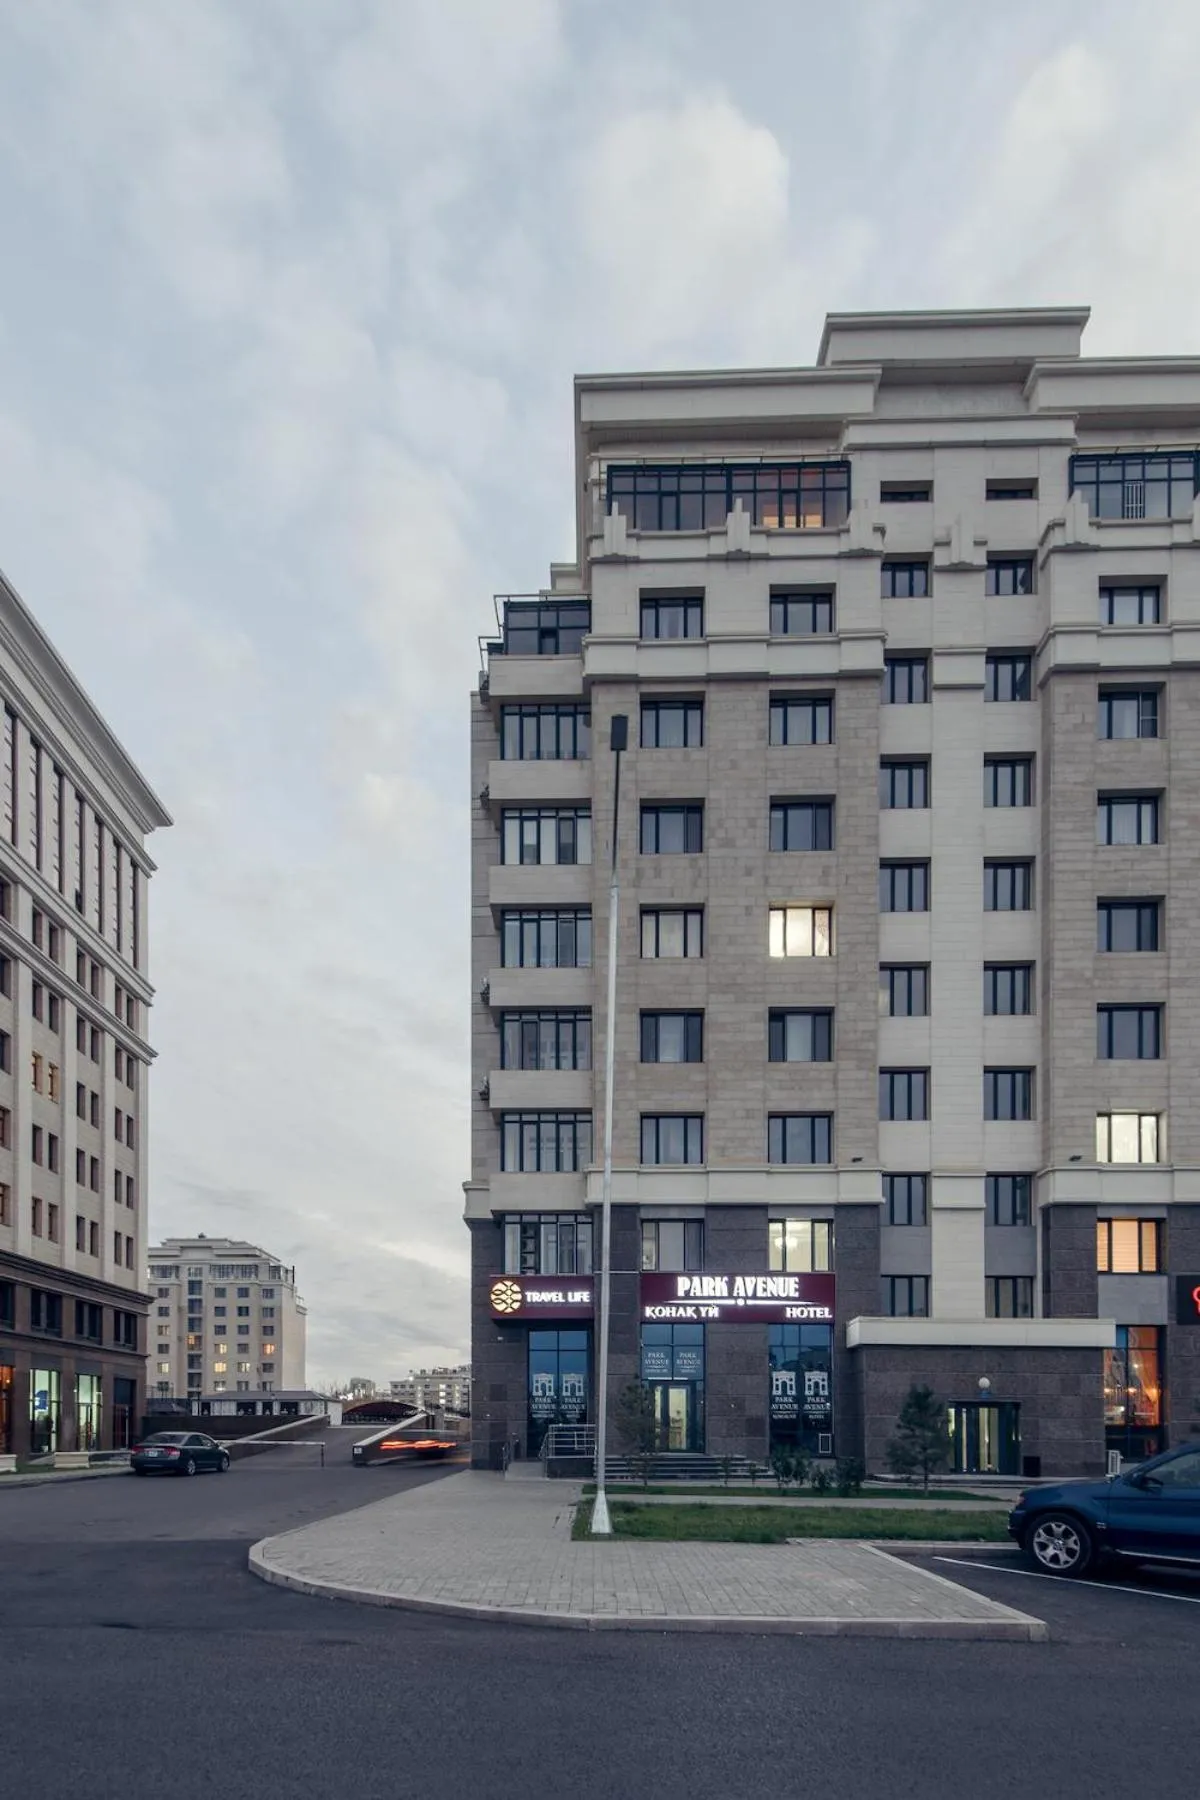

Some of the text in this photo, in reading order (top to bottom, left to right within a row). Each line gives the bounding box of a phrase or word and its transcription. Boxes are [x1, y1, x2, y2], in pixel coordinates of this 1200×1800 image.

[677, 1276, 800, 1297] PARK AVENUE
[525, 1291, 591, 1302] TRAVEL LIFE
[785, 1306, 833, 1318] HOTEL
